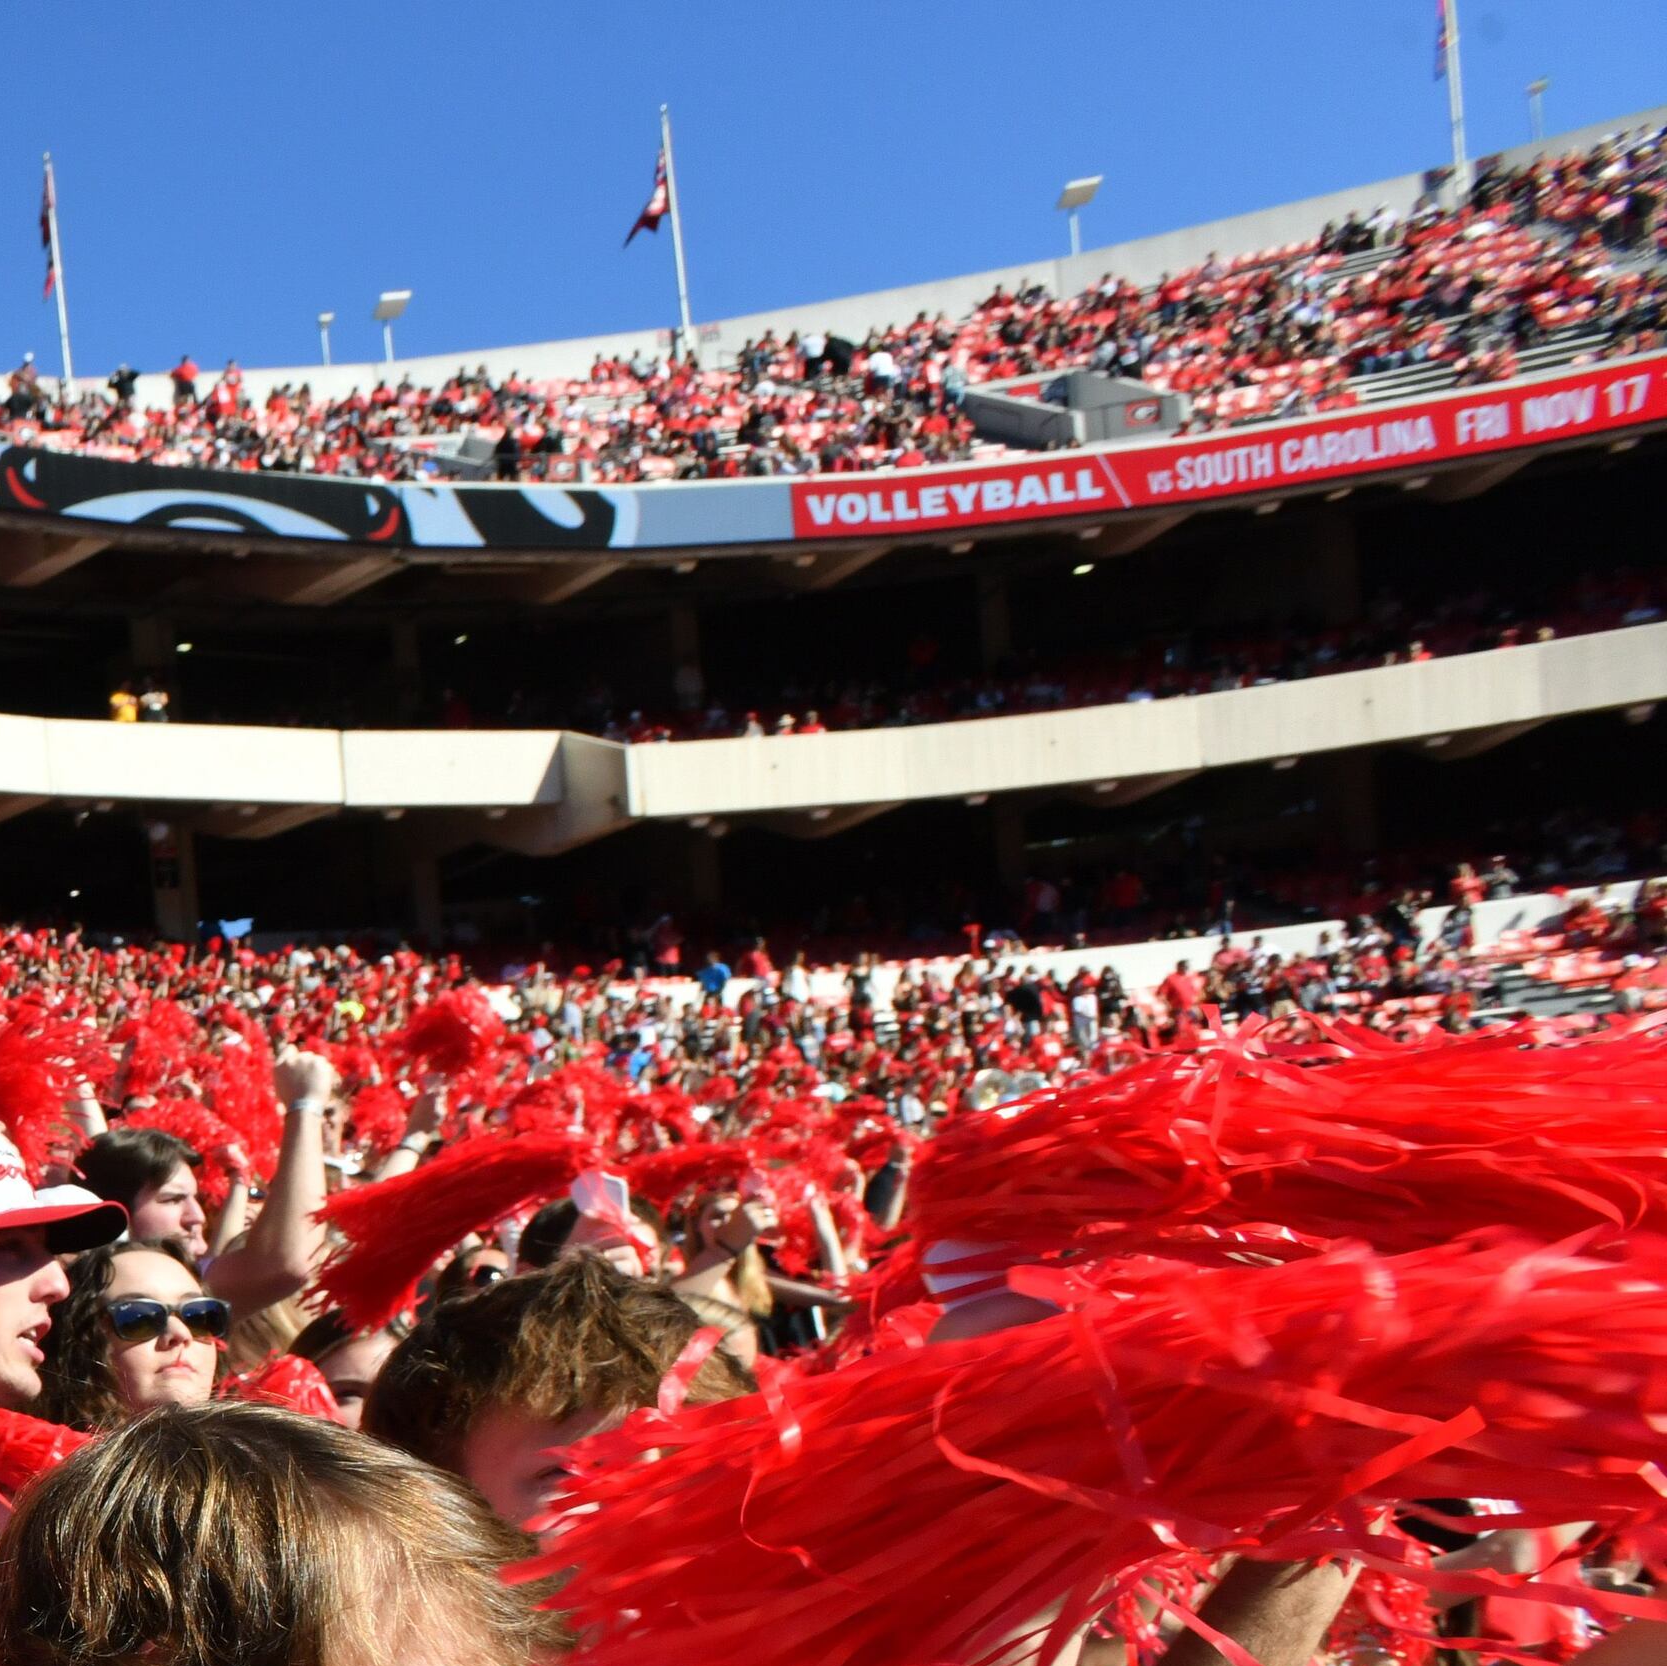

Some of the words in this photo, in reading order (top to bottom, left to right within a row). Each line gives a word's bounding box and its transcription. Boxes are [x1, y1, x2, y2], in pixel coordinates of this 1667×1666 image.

[805, 468, 1104, 526] VOLLEYBALL
[1176, 440, 1273, 492] SOUTH
[1278, 415, 1436, 475] CAROLINA
[1455, 401, 1510, 446] FRI
[1522, 384, 1596, 434] NOV
[1603, 373, 1650, 417] 17
